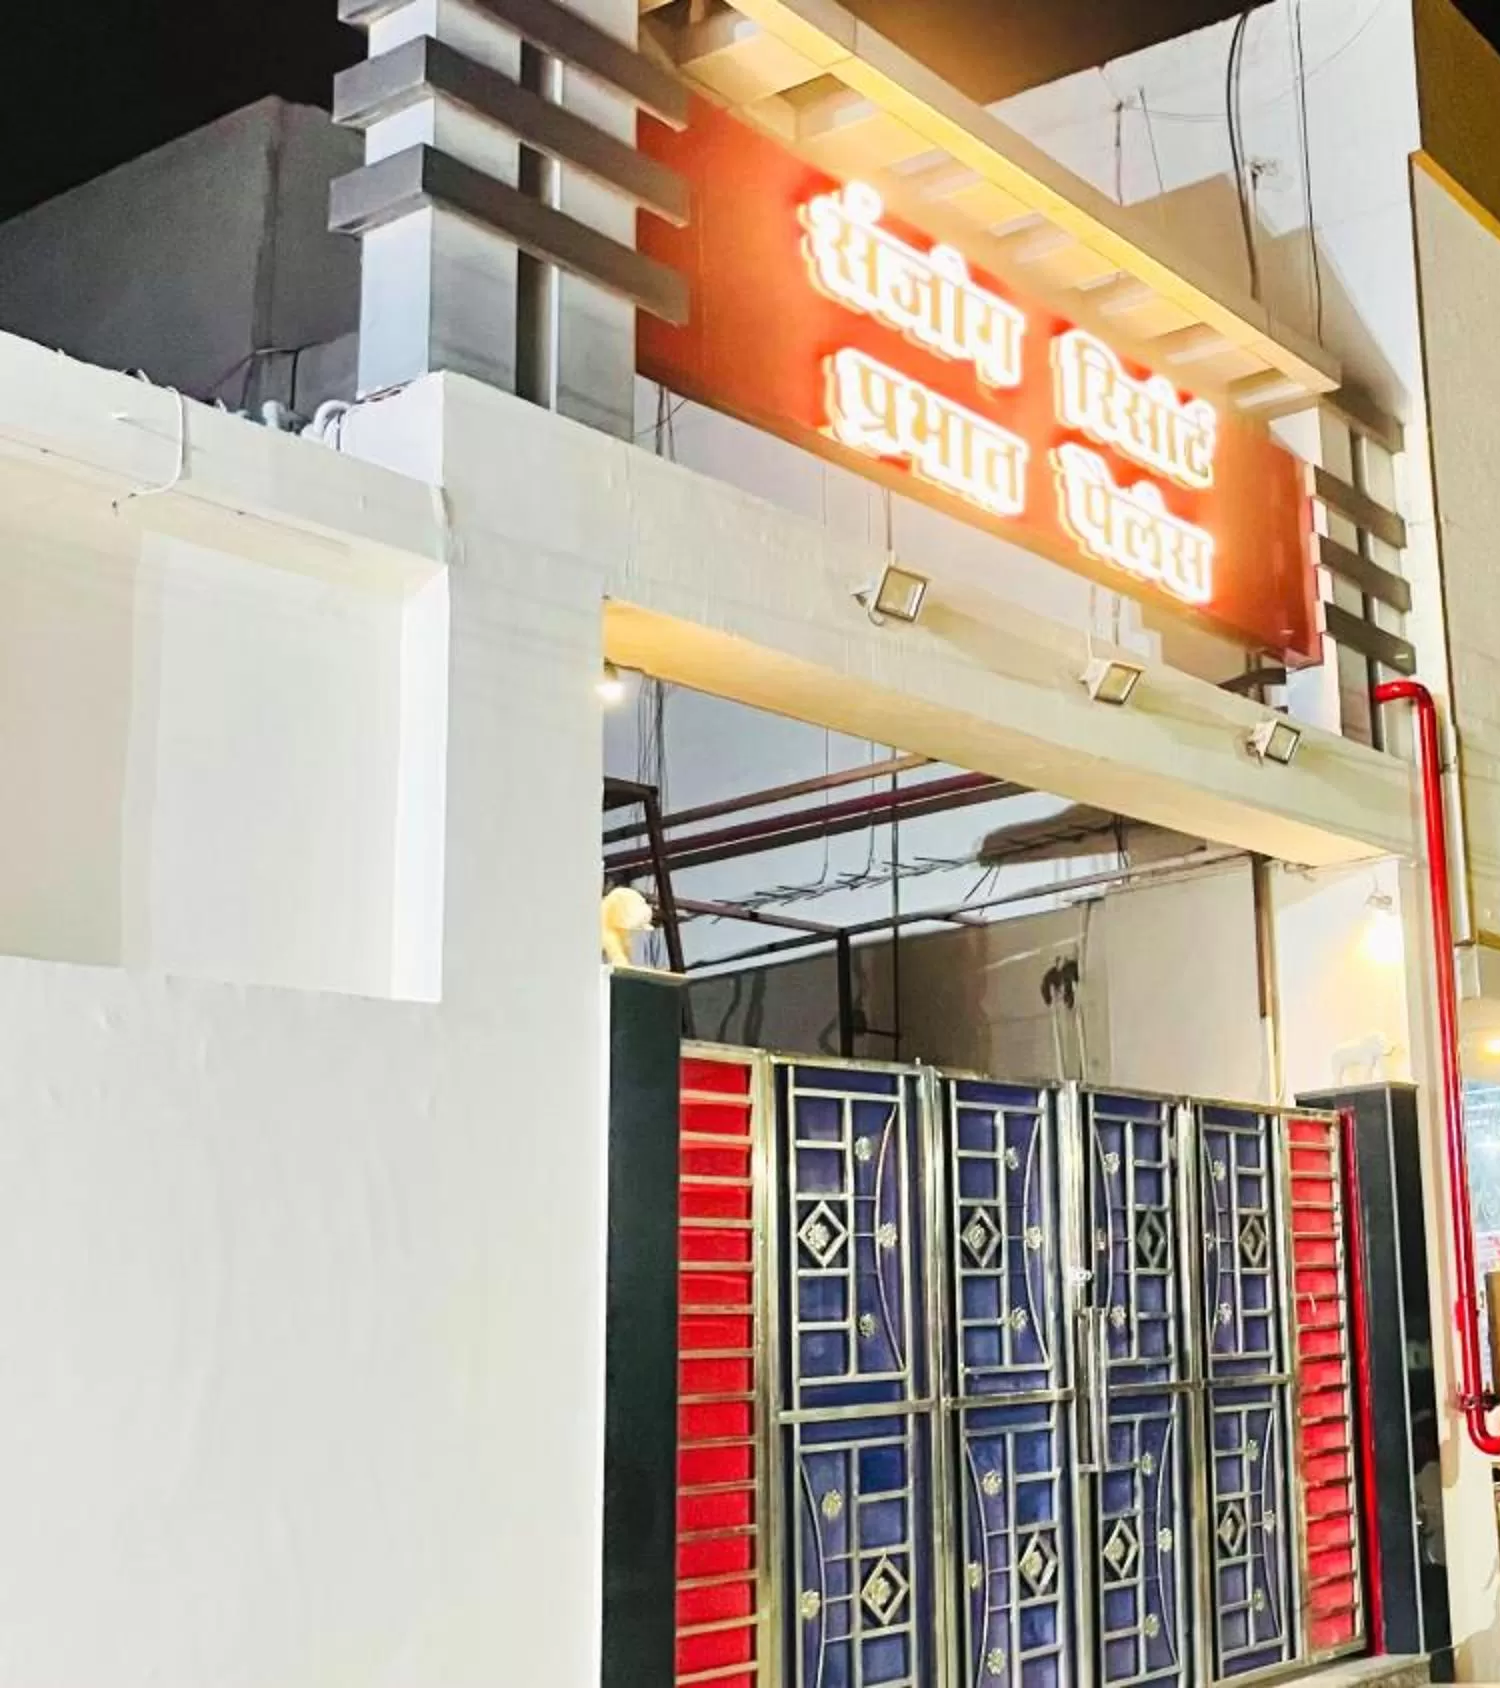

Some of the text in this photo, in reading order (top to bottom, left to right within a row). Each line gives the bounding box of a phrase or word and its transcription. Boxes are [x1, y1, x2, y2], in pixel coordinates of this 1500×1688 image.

[803, 180, 1216, 488] संजोग रिसोर्ट
[828, 348, 1027, 516] प्रभात
